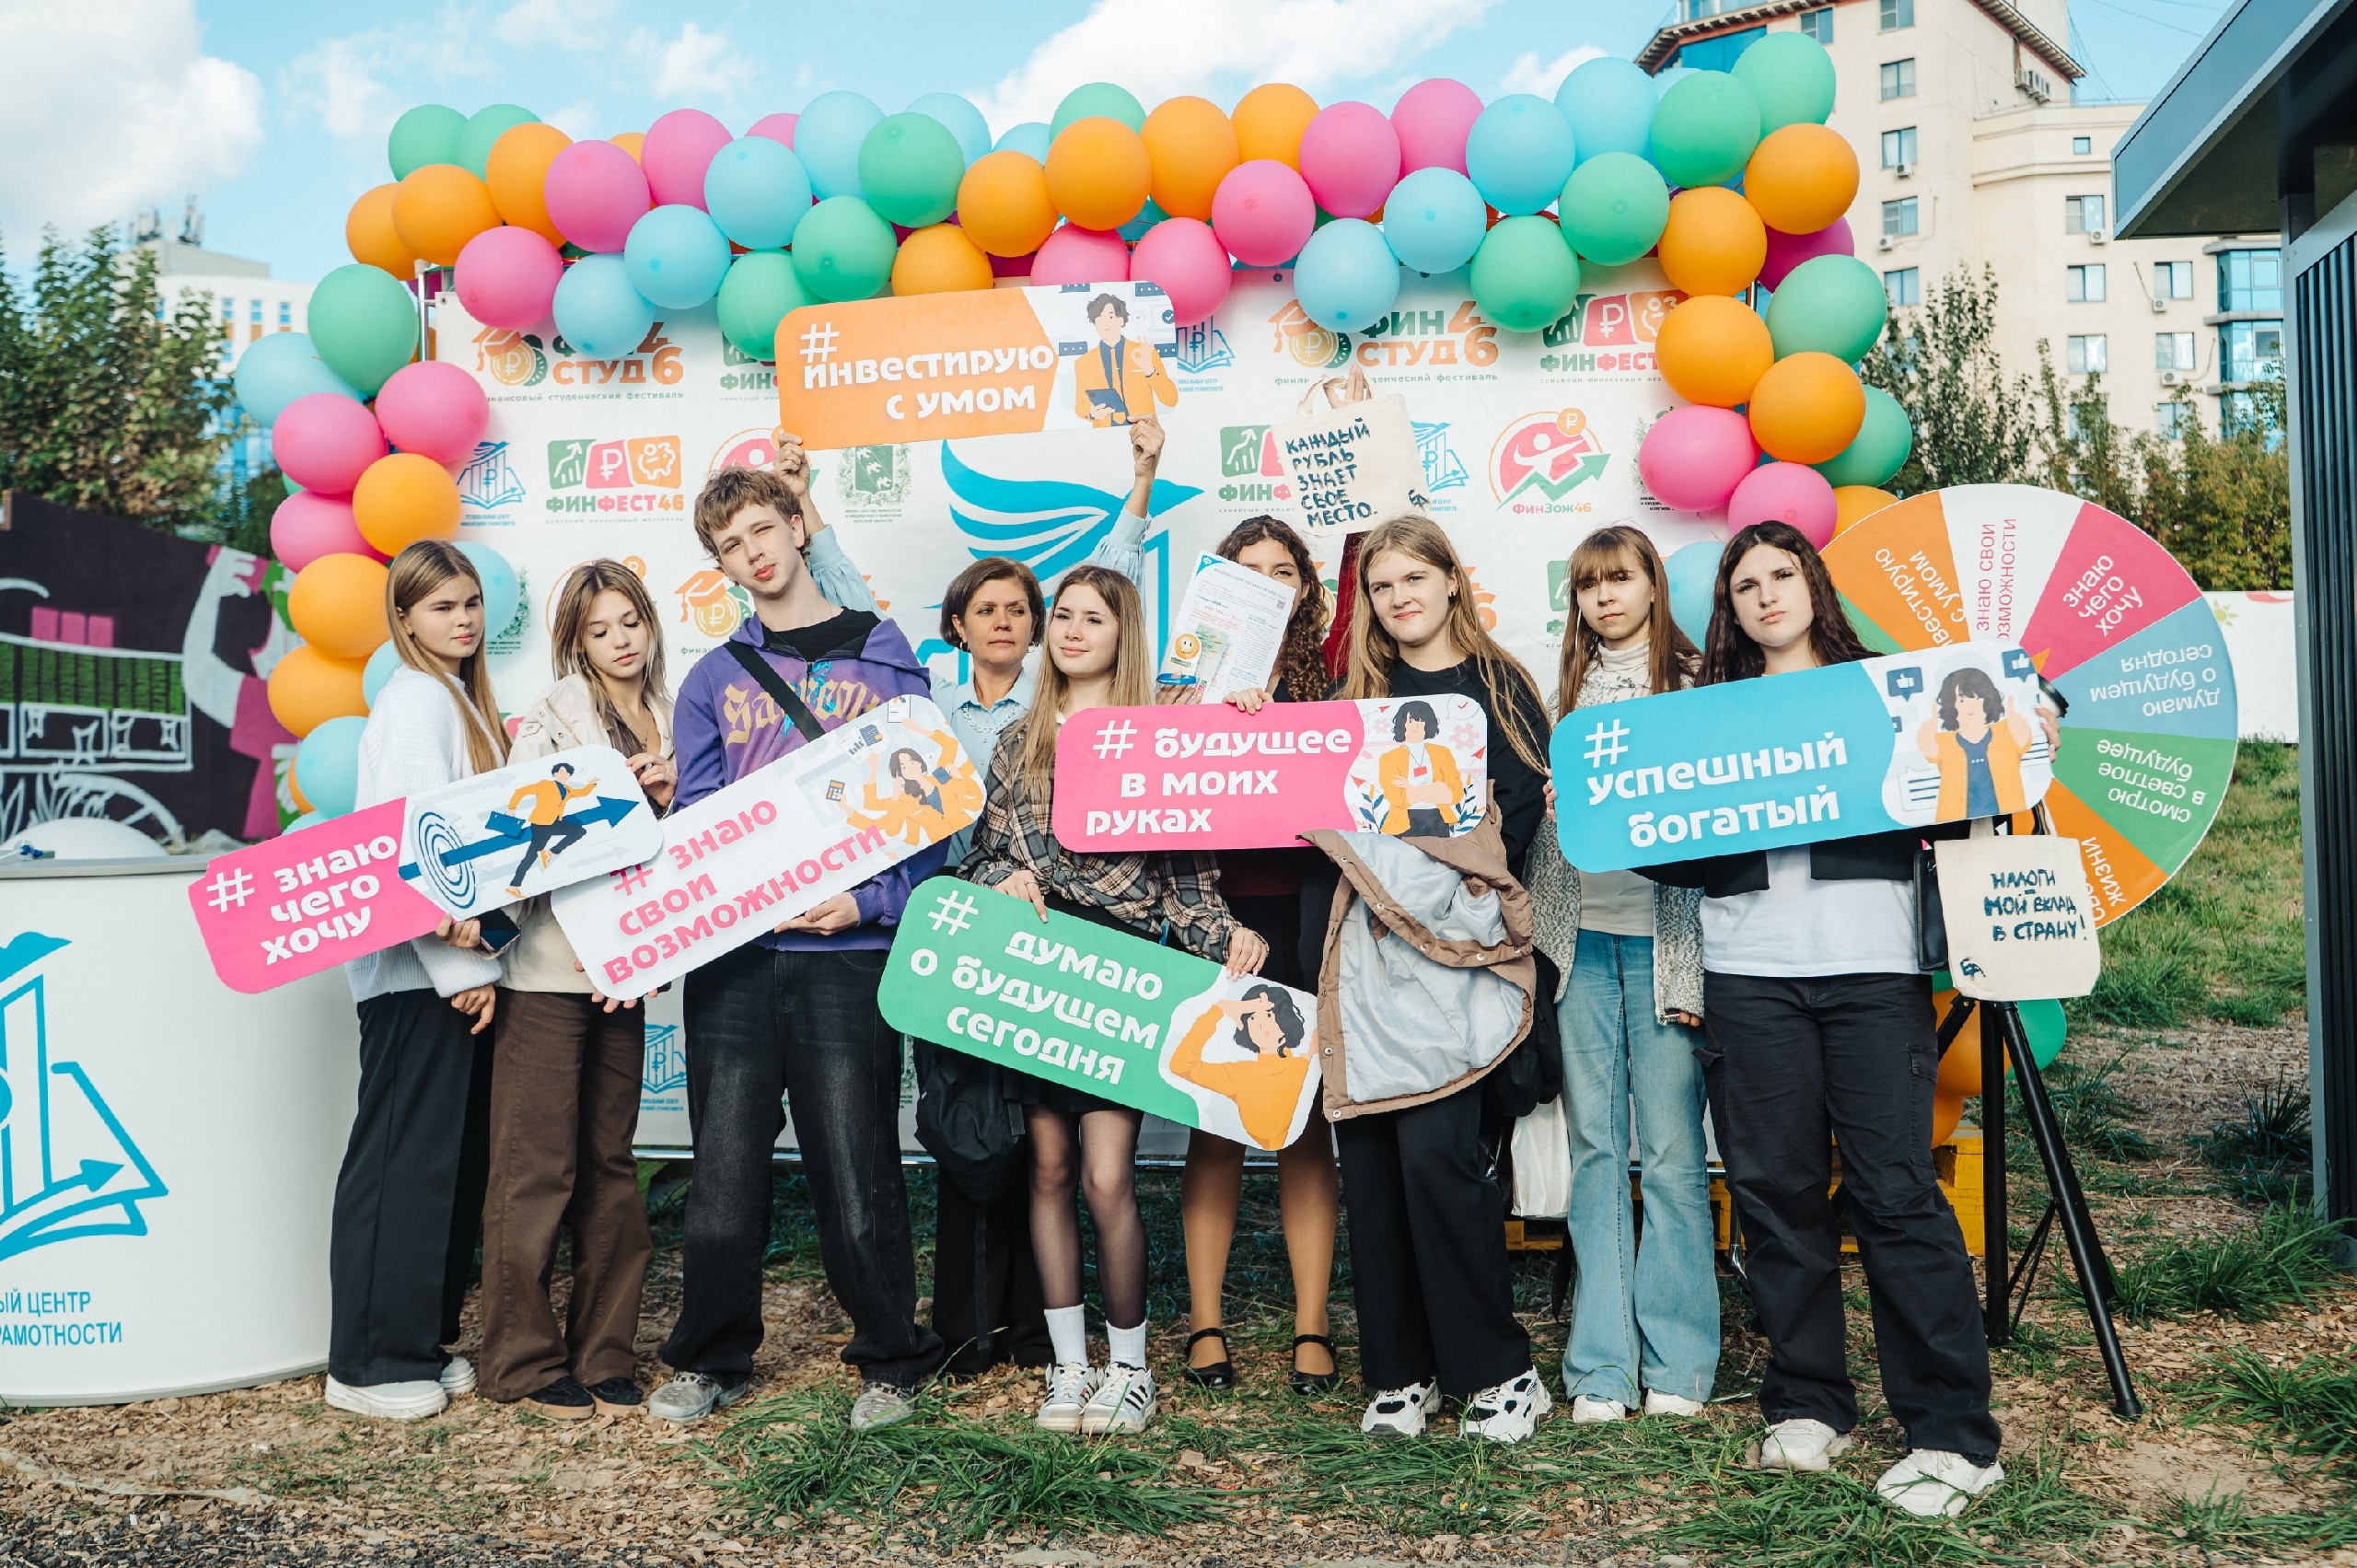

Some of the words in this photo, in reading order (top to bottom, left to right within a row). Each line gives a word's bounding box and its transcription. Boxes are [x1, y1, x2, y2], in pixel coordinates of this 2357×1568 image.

[804, 344, 1054, 389] инвестирую
[1372, 374, 1431, 383] енческий
[1436, 373, 1498, 382] фестиваль
[487, 394, 543, 402] нансовый
[549, 393, 621, 401] студенческий
[626, 391, 683, 401] фестиваль
[887, 394, 905, 420] с
[917, 384, 1036, 420] умом
[1284, 417, 1371, 455] КАЖДЫЙ
[1292, 447, 1355, 471] РУБЛЬ
[1297, 464, 1357, 492] ЗНАЕТ
[545, 494, 684, 513] ФИНФЕСТ46
[1301, 489, 1351, 510] СВОЕ
[1980, 524, 1995, 572] свои
[1875, 548, 1953, 646] вестирую
[1909, 551, 1961, 609] умом
[1997, 518, 2017, 641] зможности
[2062, 555, 2114, 608] знаю
[2077, 575, 2124, 619] чего
[1976, 579, 1992, 632] знаю
[2095, 586, 2143, 637] хочу
[2120, 645, 2213, 673] сегодня
[2201, 668, 2217, 683] о
[2090, 670, 2196, 702] будущем
[2142, 688, 2220, 717] думаю
[1155, 727, 1353, 759] будущее
[2096, 738, 2194, 783] будущее
[1120, 772, 1146, 798] в
[1162, 769, 1279, 796] моих
[1587, 731, 1848, 805] успешный
[2097, 762, 2187, 799] светлое
[1086, 807, 1213, 836] руках
[1628, 784, 1840, 848] богатый
[2107, 787, 2192, 823] смотрю
[668, 800, 777, 870] знаю
[273, 835, 398, 893] знаю
[1990, 868, 2056, 890] НАЛОГИ
[2081, 836, 2126, 907] жизни
[271, 874, 379, 923] чего
[603, 825, 887, 985] возможности
[619, 873, 718, 936] свои
[1983, 893, 2027, 917] МОЙ
[2034, 896, 2077, 915] ВКЛАД
[261, 908, 372, 965] хочу
[1004, 930, 1163, 1001] думаю
[911, 947, 938, 977] о
[950, 955, 1161, 1051] будущем
[946, 1005, 1125, 1086] сегодня
[28, 1291, 91, 1318] ЦЕНТР
[0, 1321, 122, 1345] АМОТНОСТИ
